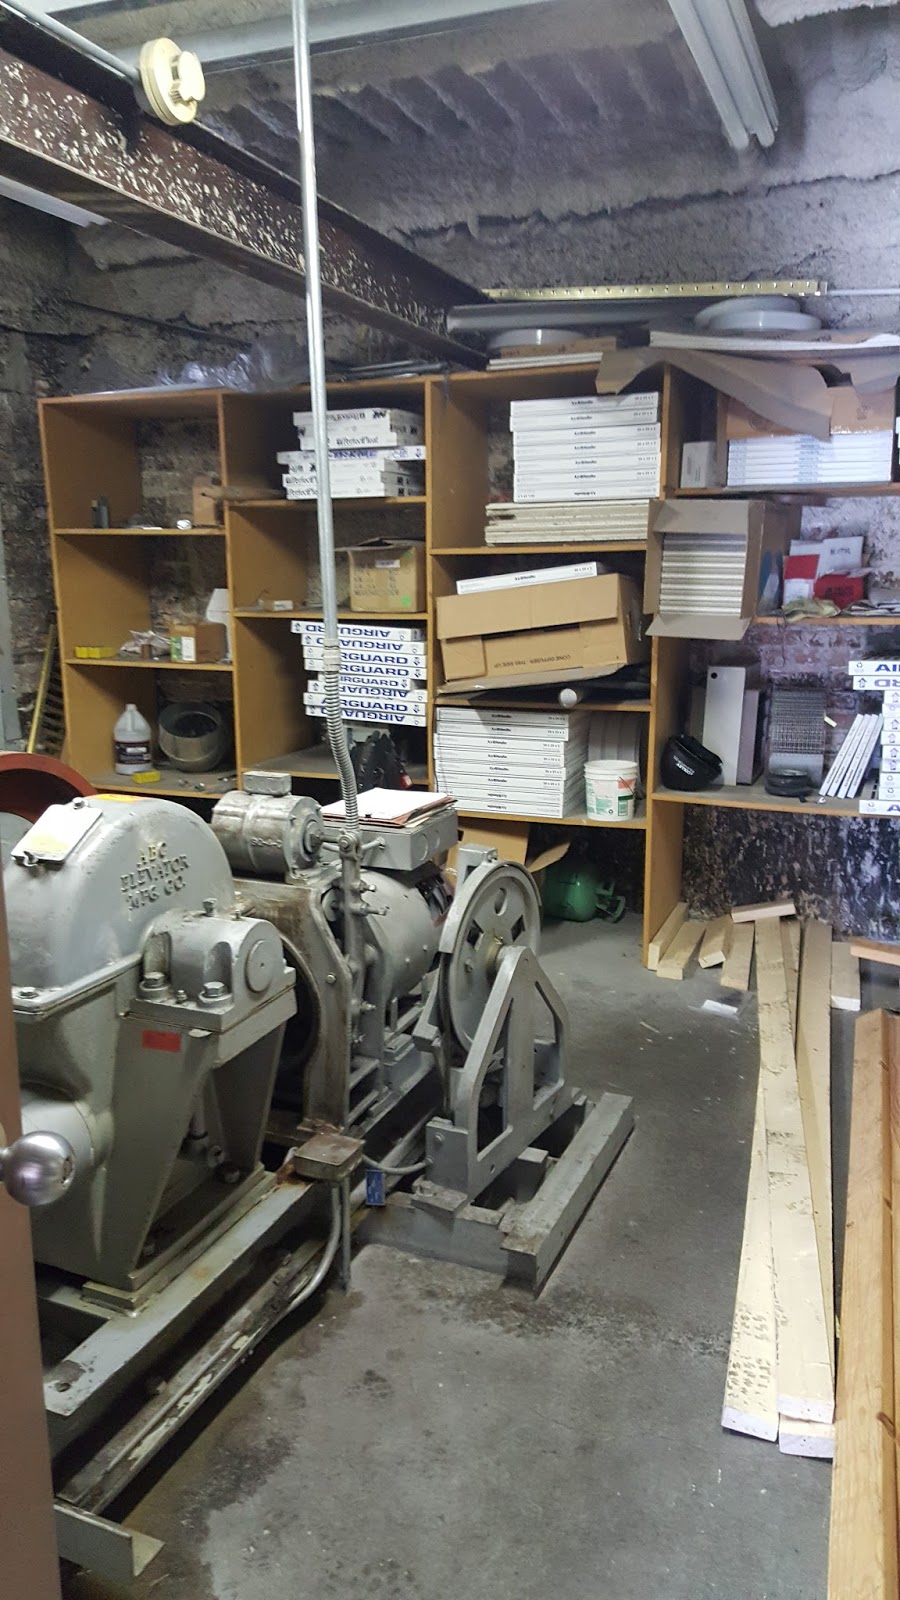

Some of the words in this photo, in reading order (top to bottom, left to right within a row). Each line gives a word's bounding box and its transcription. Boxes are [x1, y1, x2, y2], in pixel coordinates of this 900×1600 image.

[305, 624, 391, 638] AIRGURD
[316, 639, 404, 652] AIRGUAD
[340, 675, 399, 687] IRGUARD
[340, 686, 408, 698] AIRGUAR
[321, 709, 405, 722] AIRGUAD
[120, 855, 190, 893] ELEVATOR
